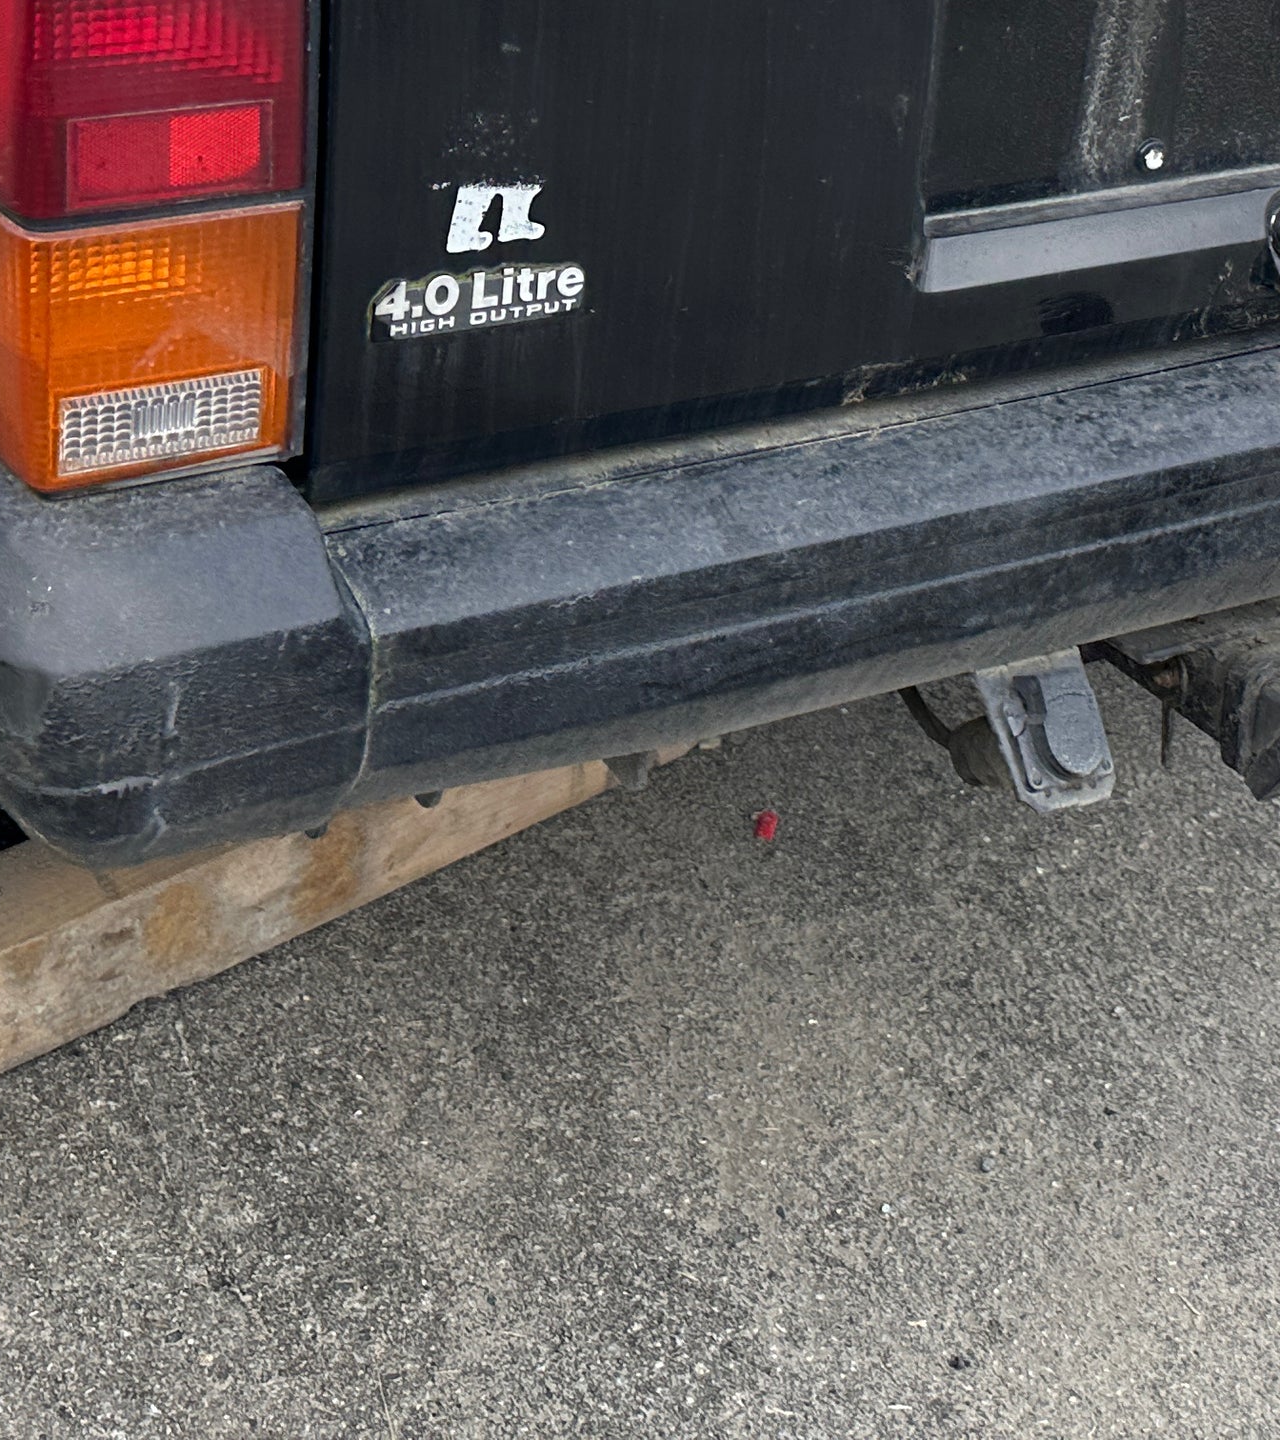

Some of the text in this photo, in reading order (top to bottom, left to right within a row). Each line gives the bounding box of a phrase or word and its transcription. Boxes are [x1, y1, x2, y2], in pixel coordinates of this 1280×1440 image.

[374, 266, 585, 322] 4.0 Litre
[389, 298, 577, 337] HIGH OUTPUT
